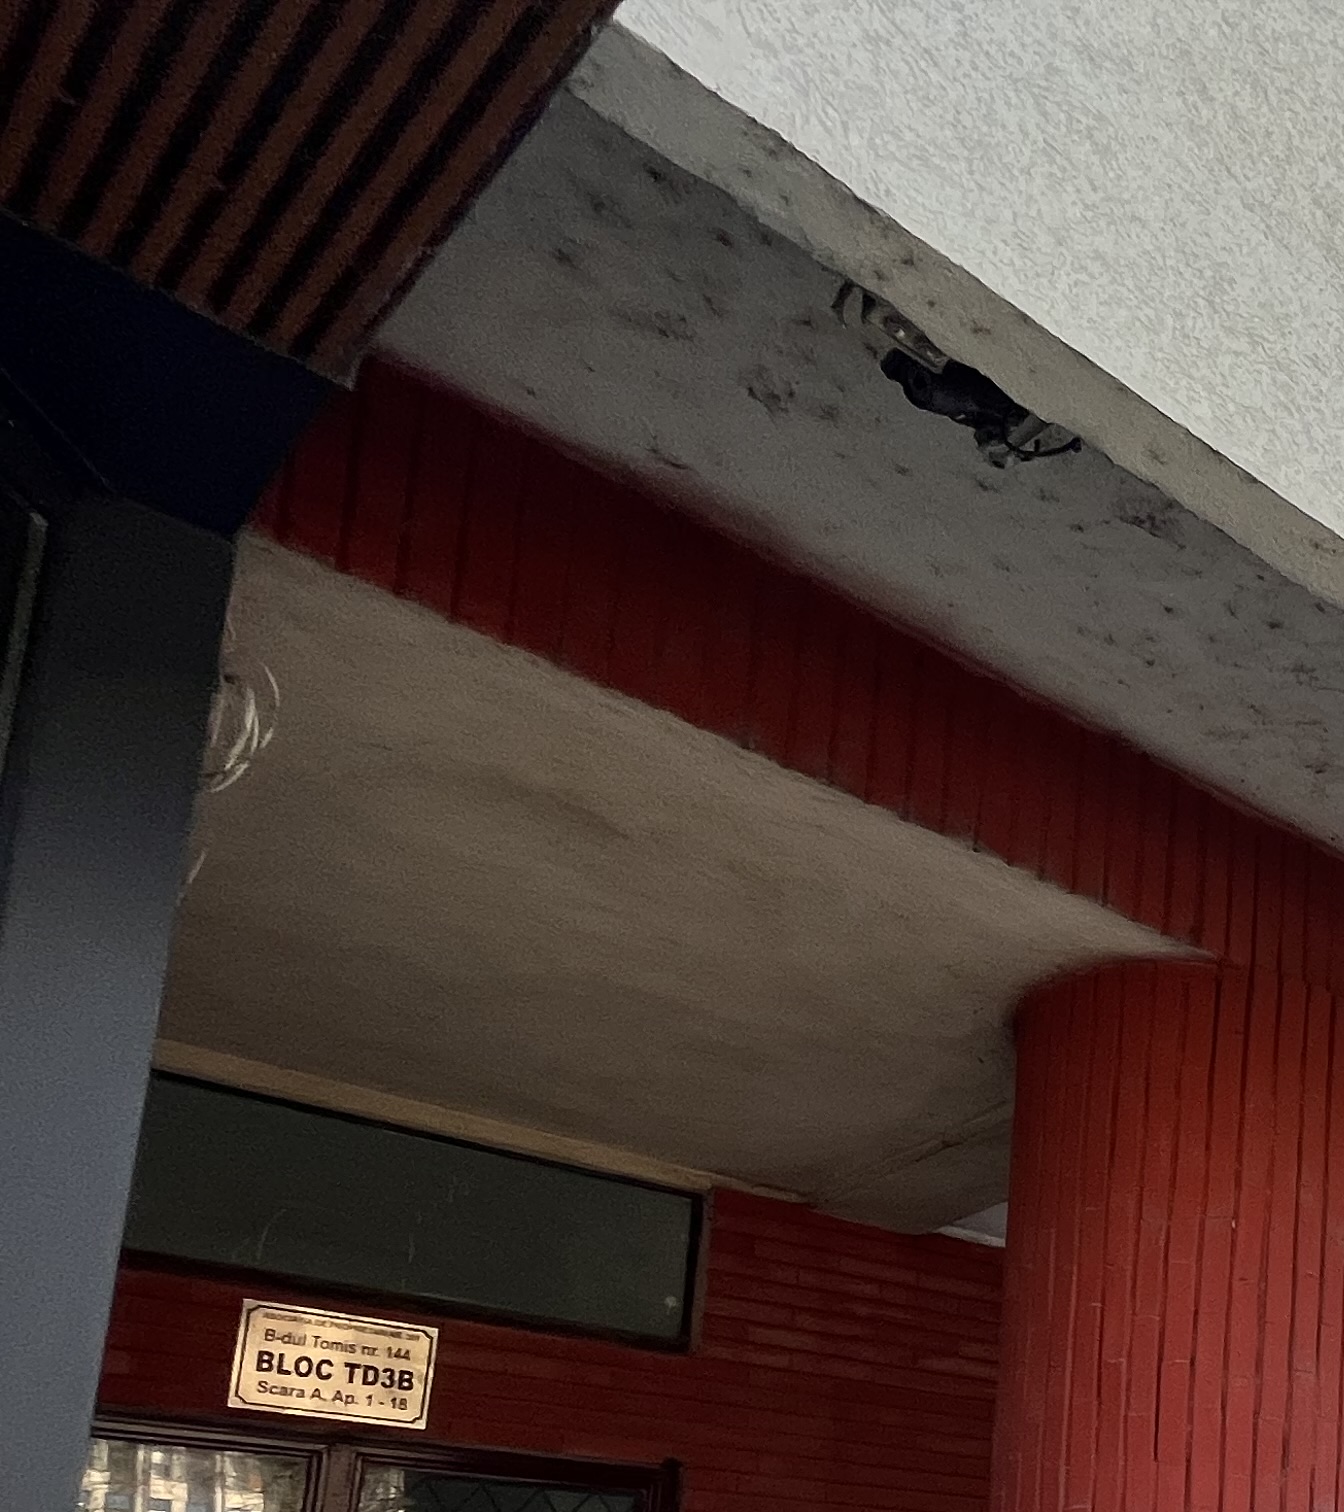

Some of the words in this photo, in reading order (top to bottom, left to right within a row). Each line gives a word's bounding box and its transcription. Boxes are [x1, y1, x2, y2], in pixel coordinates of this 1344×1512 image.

[264, 1328, 307, 1346] B-dul
[256, 1350, 334, 1380] BLOC
[344, 1361, 414, 1391] TD3B
[256, 1380, 306, 1399] Scara
